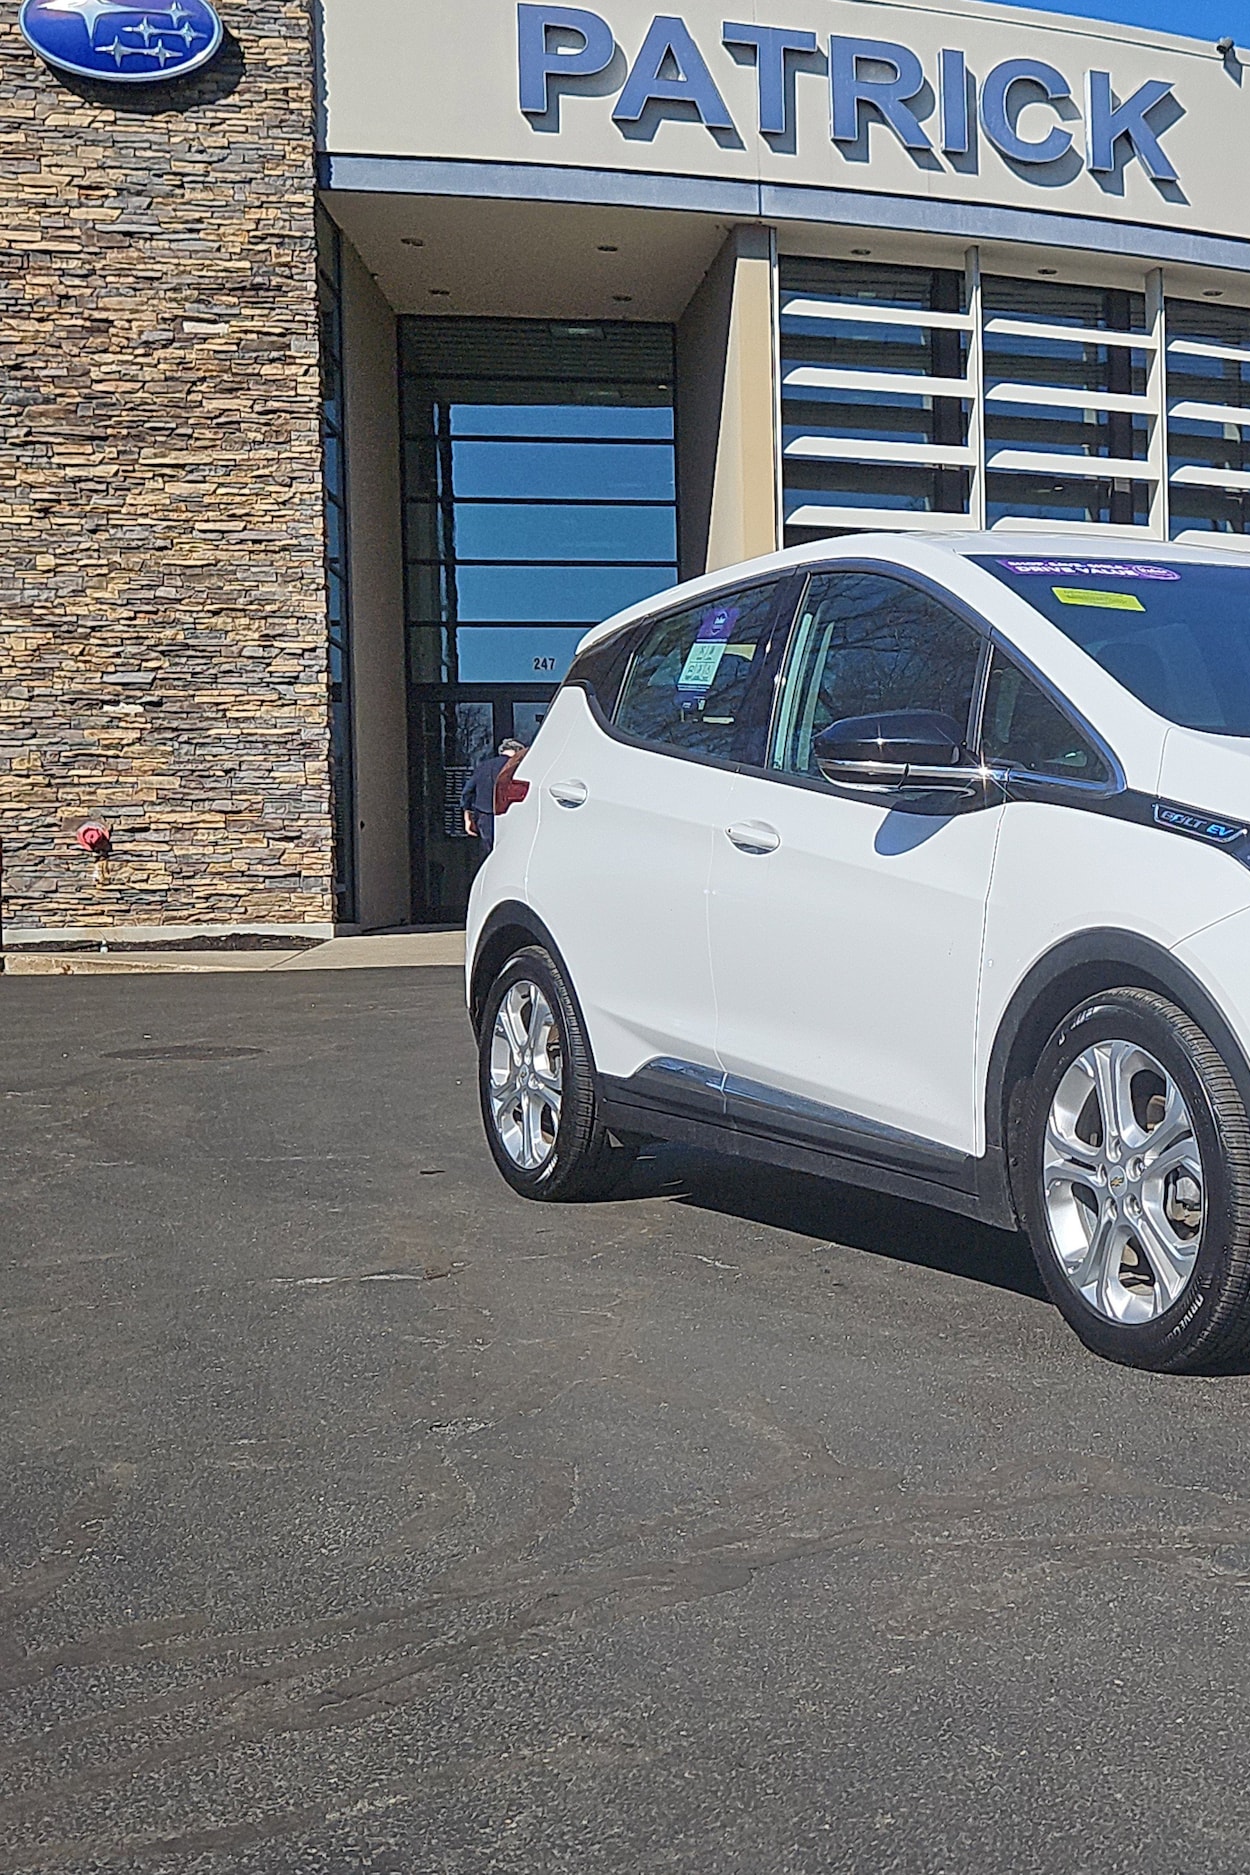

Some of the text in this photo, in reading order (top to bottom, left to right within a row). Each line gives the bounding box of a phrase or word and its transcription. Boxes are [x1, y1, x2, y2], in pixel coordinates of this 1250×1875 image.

[516, 2, 1181, 182] PATRICK
[1076, 567, 1139, 576] VALUE
[533, 657, 555, 670] 247
[1161, 810, 1234, 836] BOLT EV
